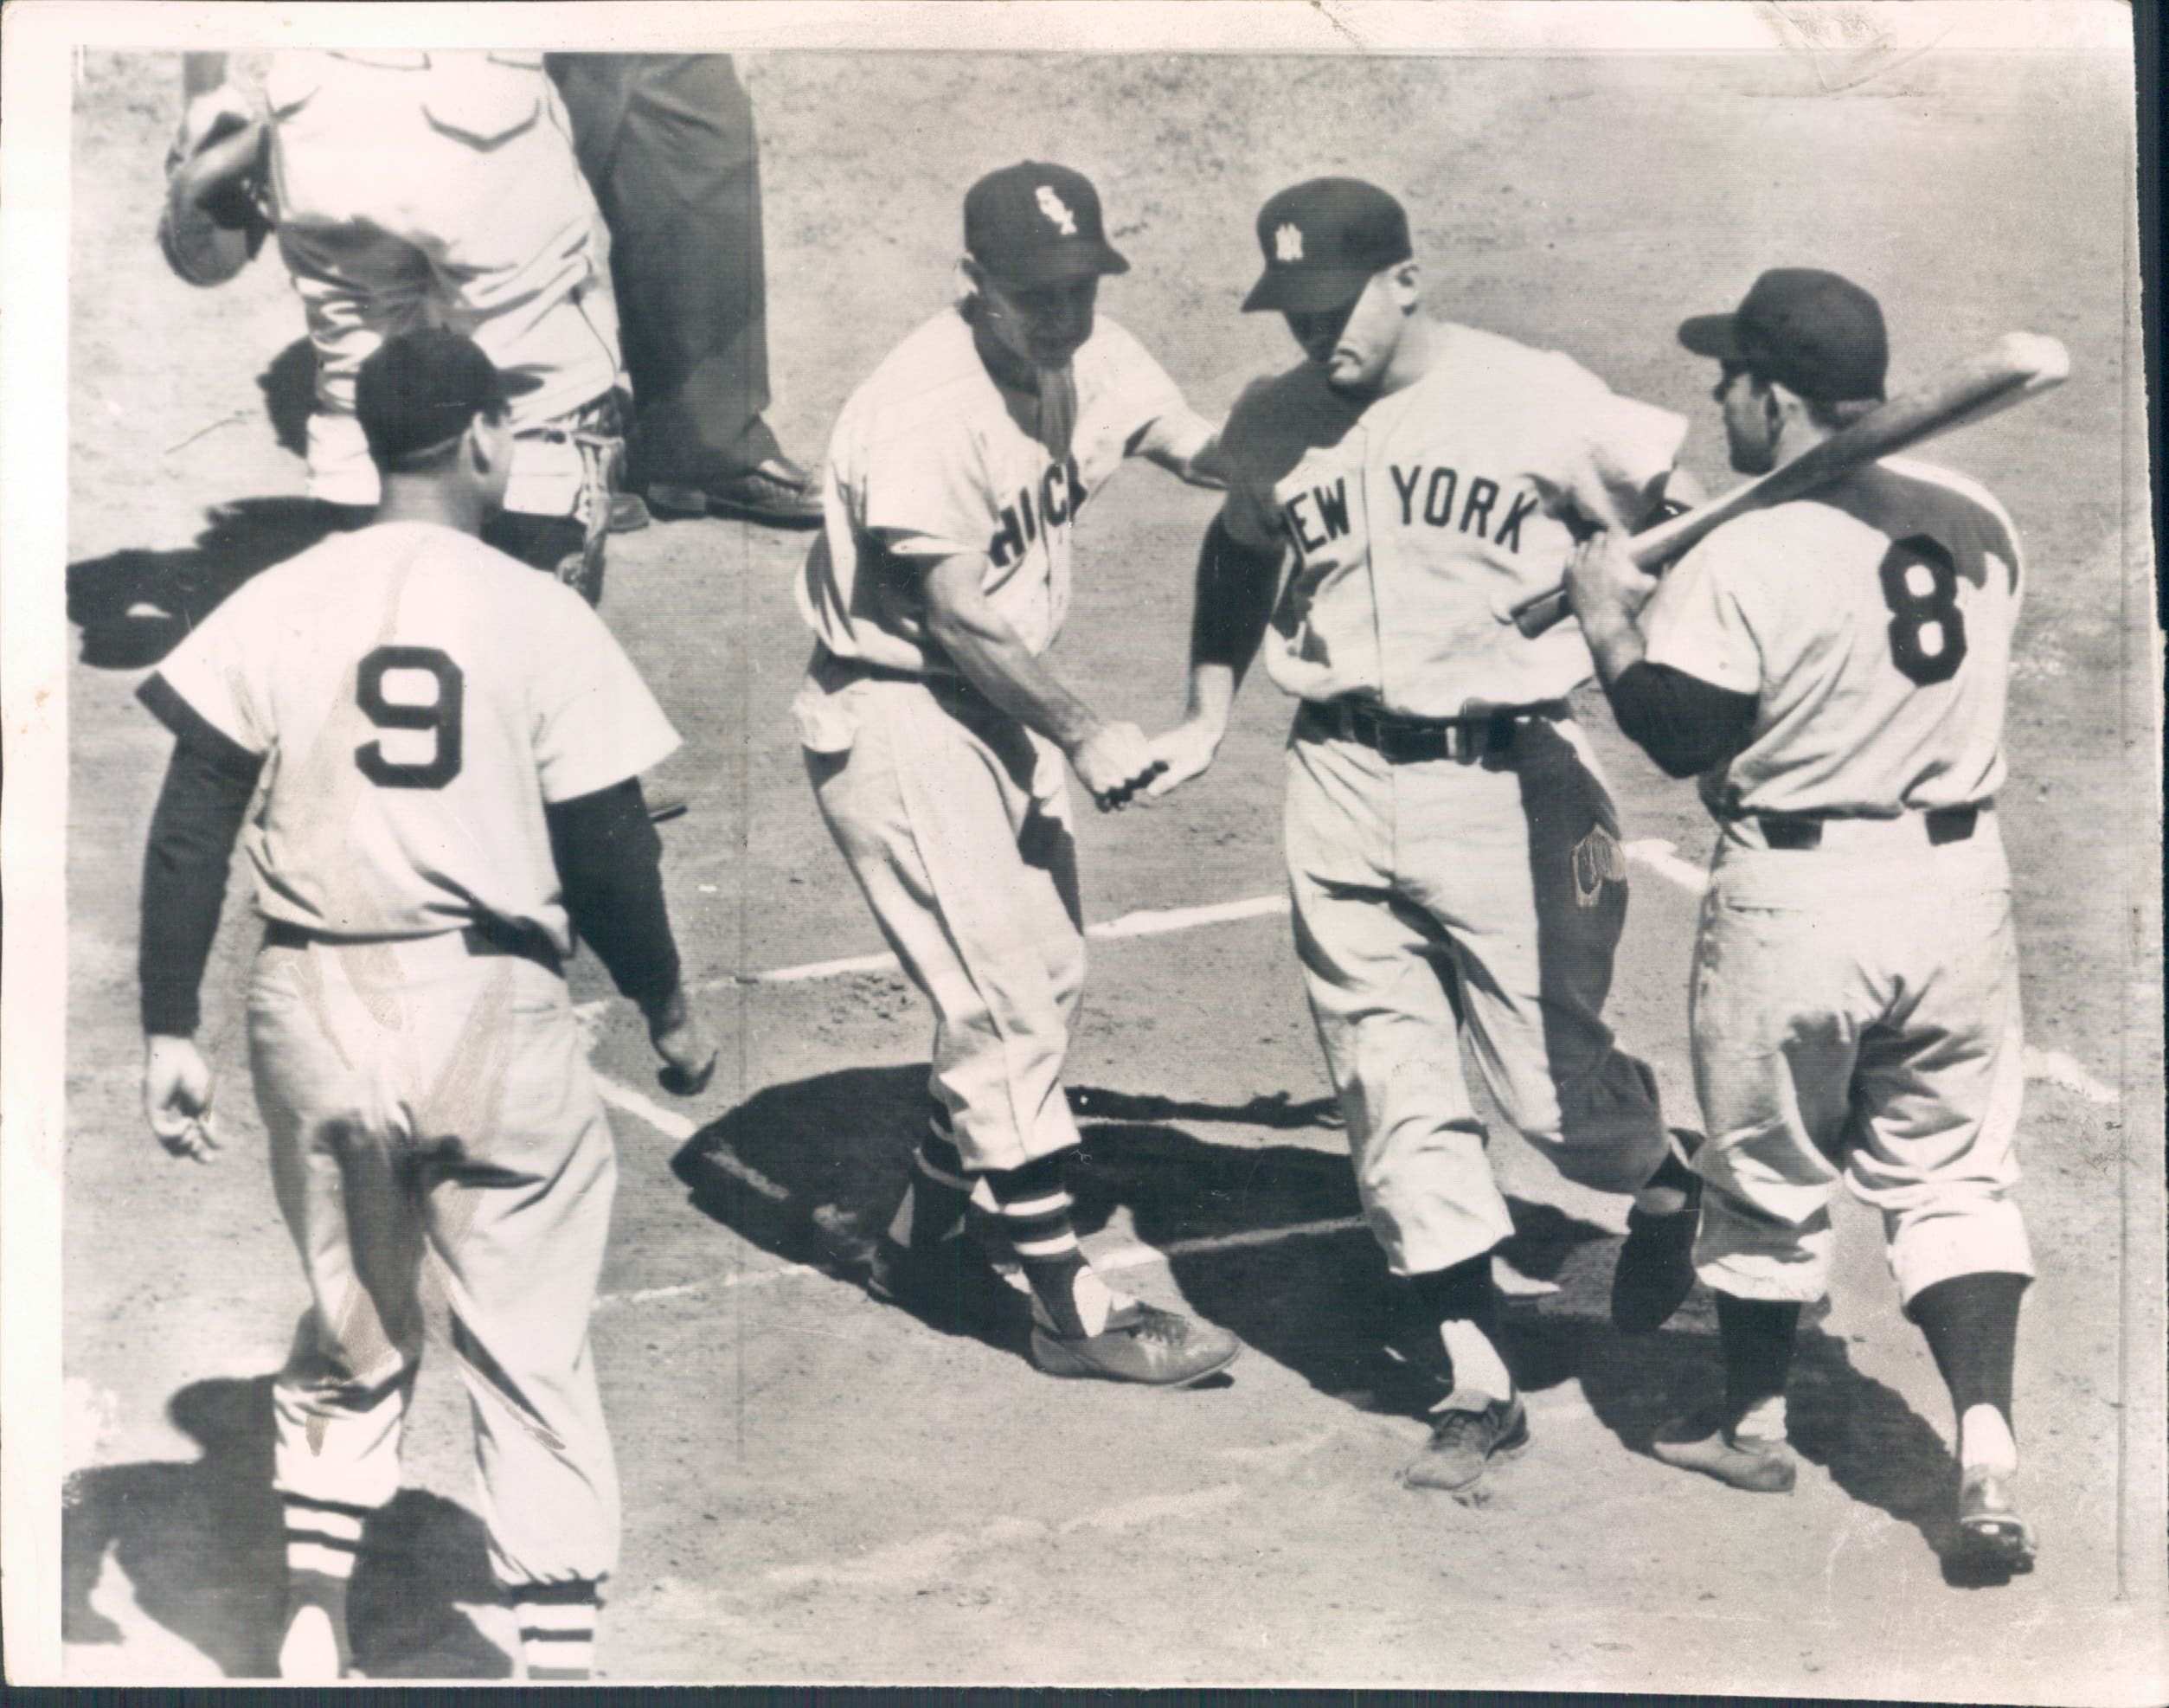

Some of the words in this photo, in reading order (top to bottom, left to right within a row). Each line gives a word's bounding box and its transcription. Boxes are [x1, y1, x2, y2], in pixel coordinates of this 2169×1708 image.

[1281, 476, 1351, 555] EW
[1389, 464, 1539, 555] YORK
[1878, 533, 1968, 689] 8
[354, 644, 465, 791] 9
